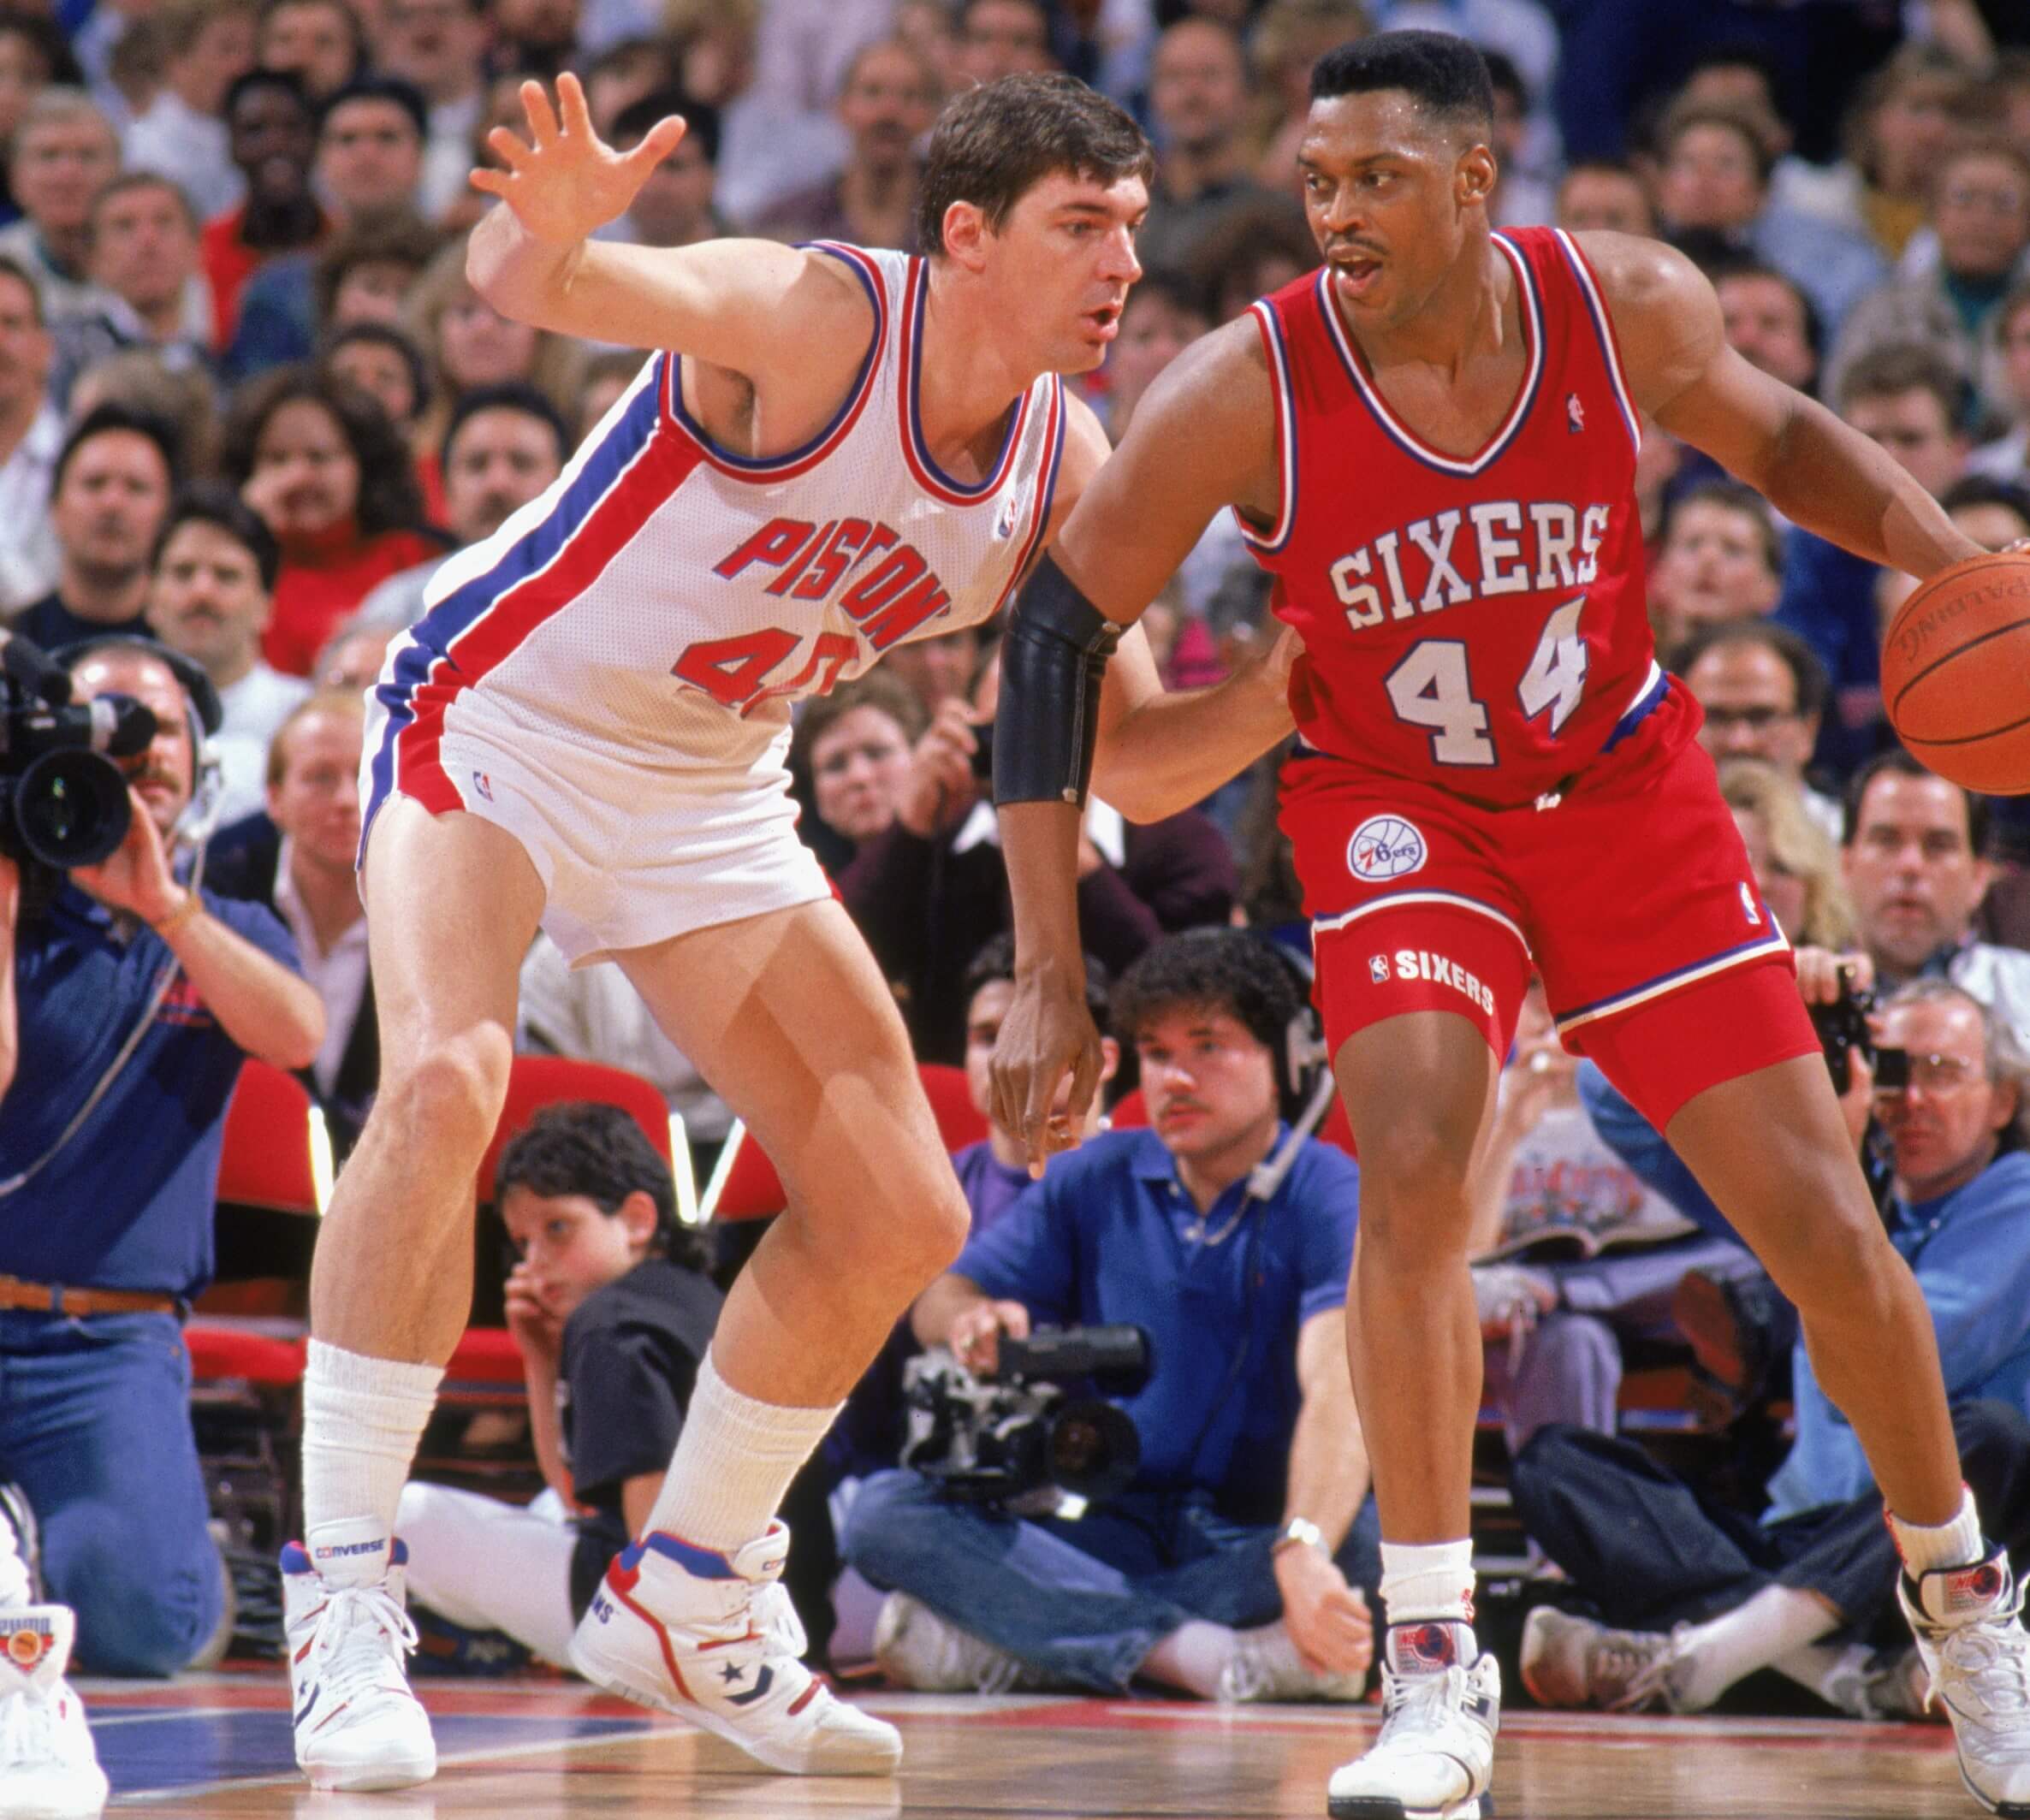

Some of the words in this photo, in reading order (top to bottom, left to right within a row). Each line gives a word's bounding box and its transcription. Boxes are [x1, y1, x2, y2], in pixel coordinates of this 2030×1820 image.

[712, 517, 953, 653] PISTON
[1329, 499, 1610, 631] SIXERS
[1383, 593, 1590, 768] 44
[1395, 949, 1494, 1017] SIXERS
[315, 1538, 386, 1559] CONVERSE
